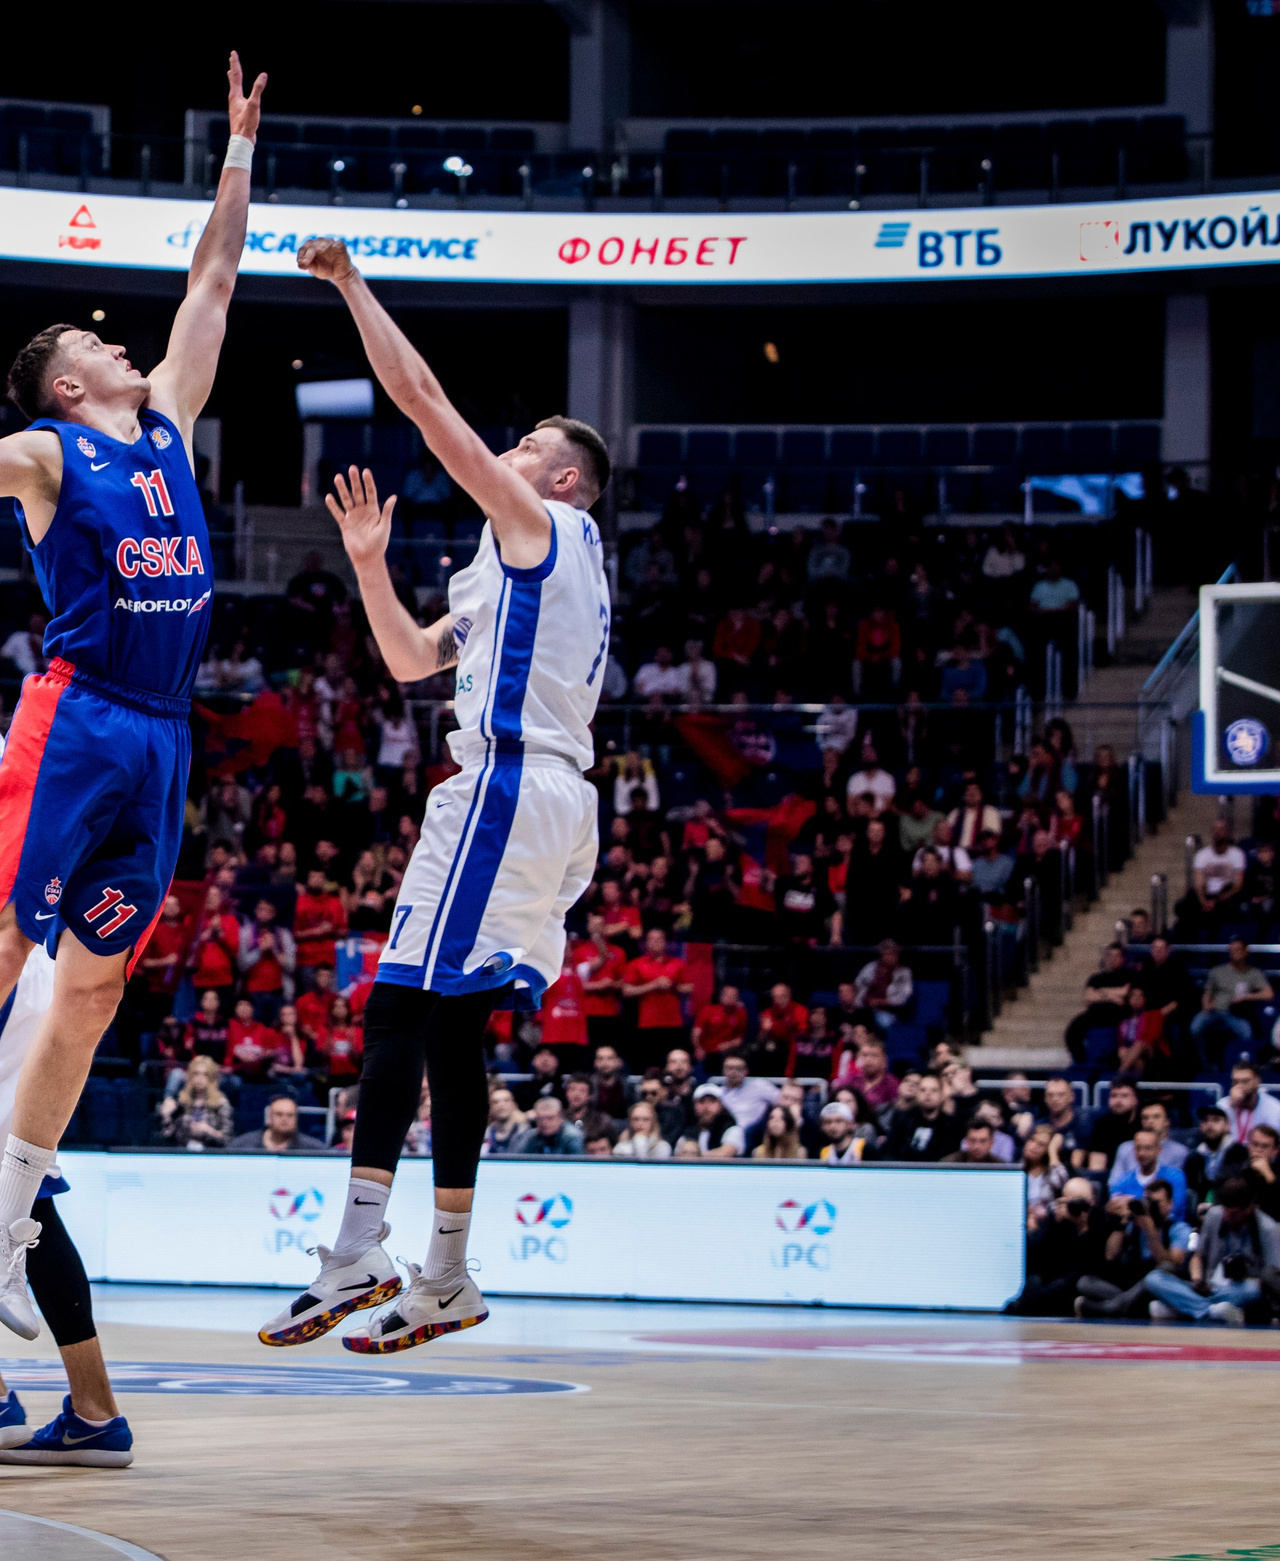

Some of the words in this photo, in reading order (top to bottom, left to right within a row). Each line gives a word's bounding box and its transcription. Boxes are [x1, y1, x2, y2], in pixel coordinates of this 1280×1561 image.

[558, 236, 748, 266] ФОНБЕТ
[918, 228, 1003, 268] ВТБ
[130, 468, 174, 516] 11
[116, 536, 204, 578] CSKA
[114, 597, 192, 613] AEROFLOT
[83, 886, 138, 939] 11
[395, 905, 413, 950] 7
